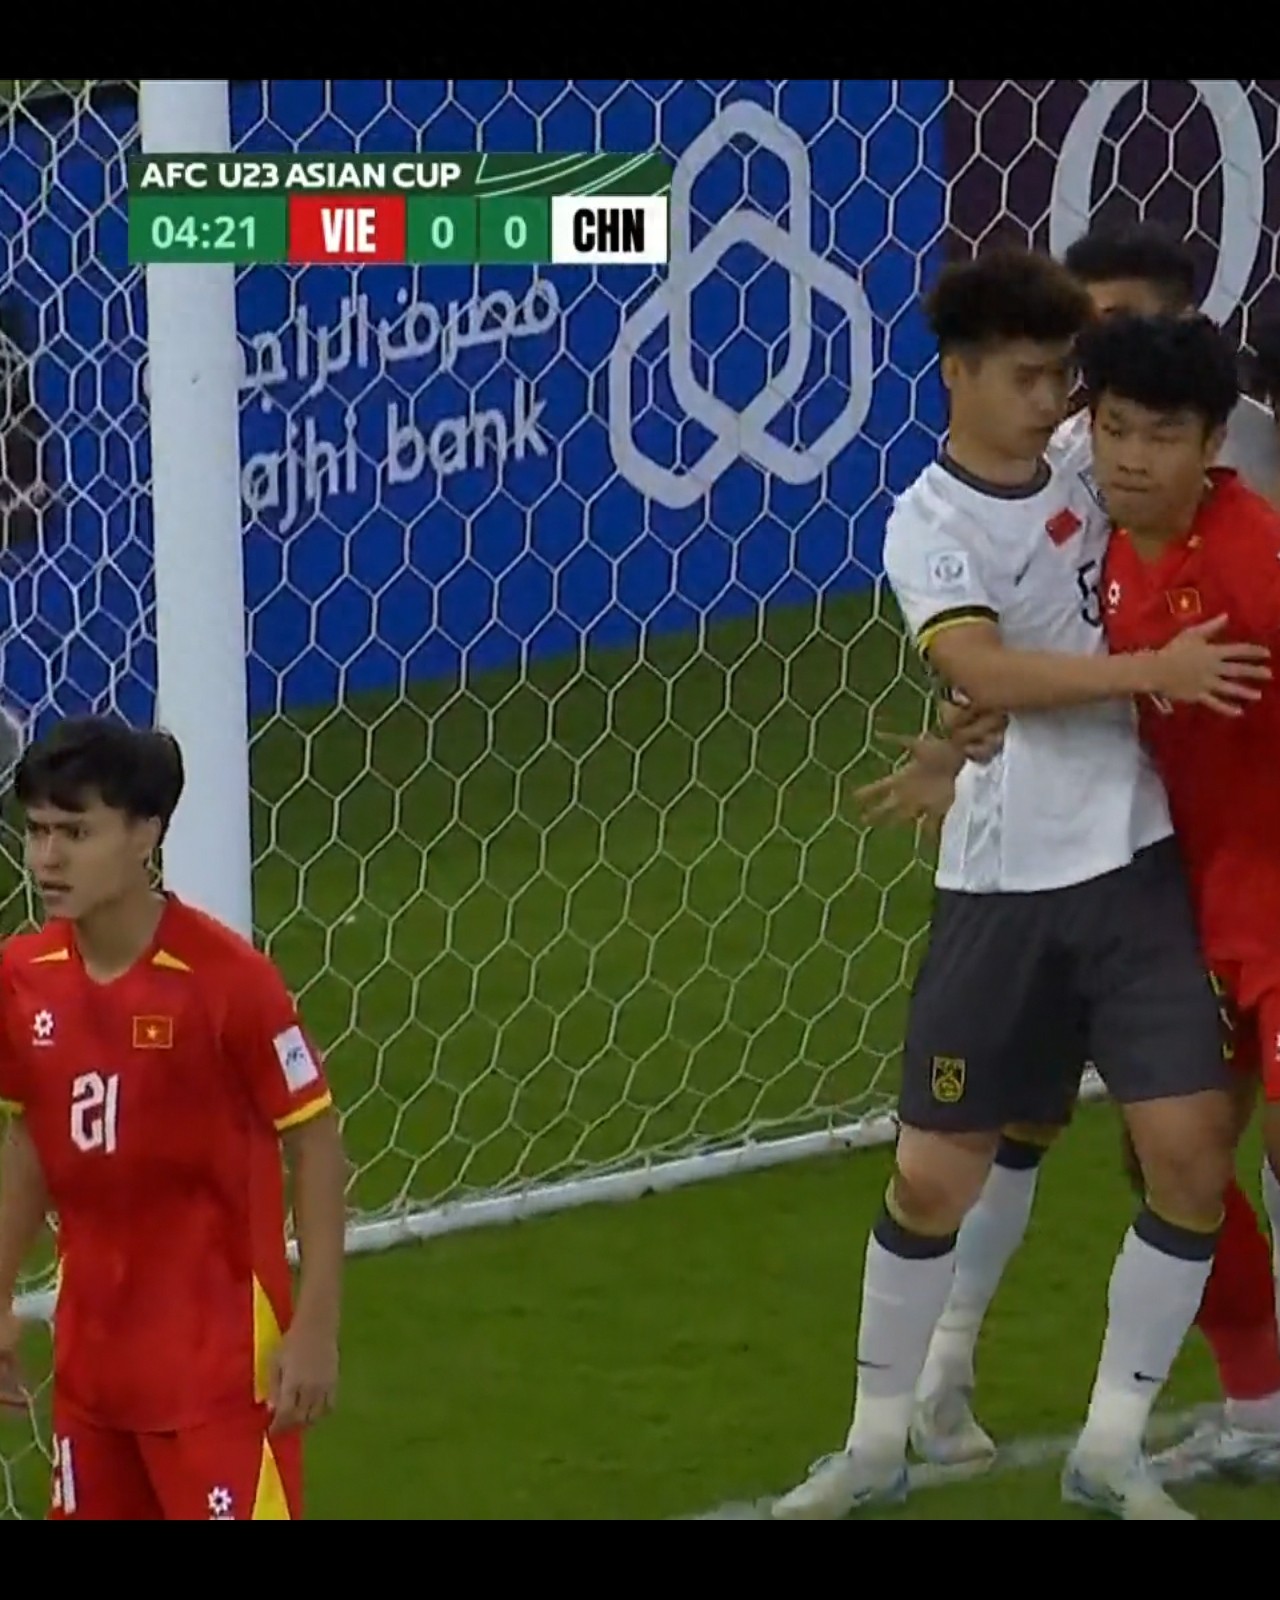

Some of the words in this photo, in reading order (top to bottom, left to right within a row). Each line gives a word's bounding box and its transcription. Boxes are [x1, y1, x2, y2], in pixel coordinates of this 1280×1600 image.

[387, 377, 549, 485] bank
[1077, 559, 1102, 628] 5
[71, 1070, 118, 1154] 21
